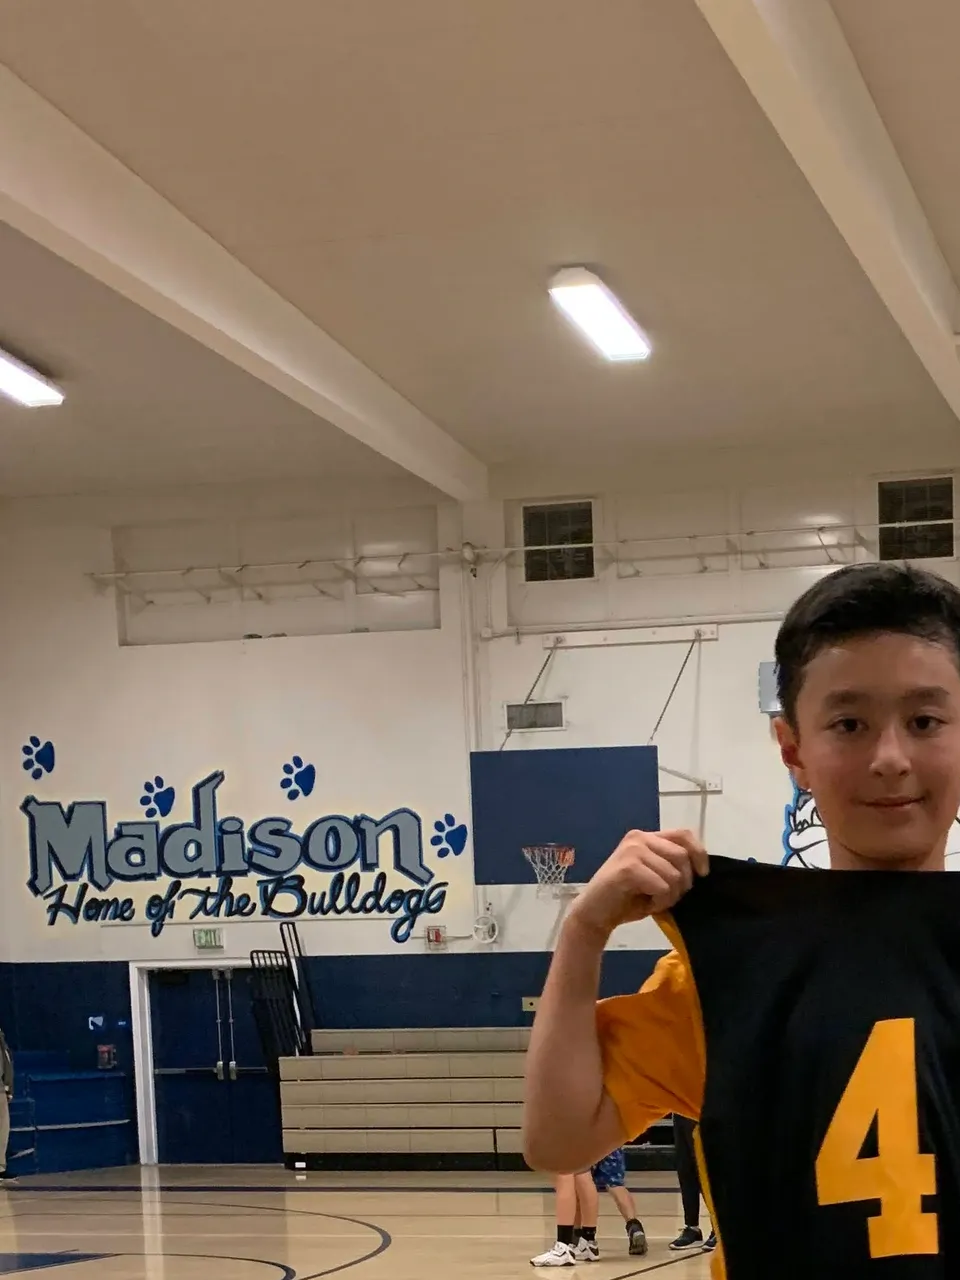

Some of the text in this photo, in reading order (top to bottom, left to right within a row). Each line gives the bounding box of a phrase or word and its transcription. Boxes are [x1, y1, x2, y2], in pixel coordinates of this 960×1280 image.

[20, 770, 434, 896] Madison
[43, 871, 449, 943] Home of the Bulldogs
[815, 1016, 940, 1259] 4
